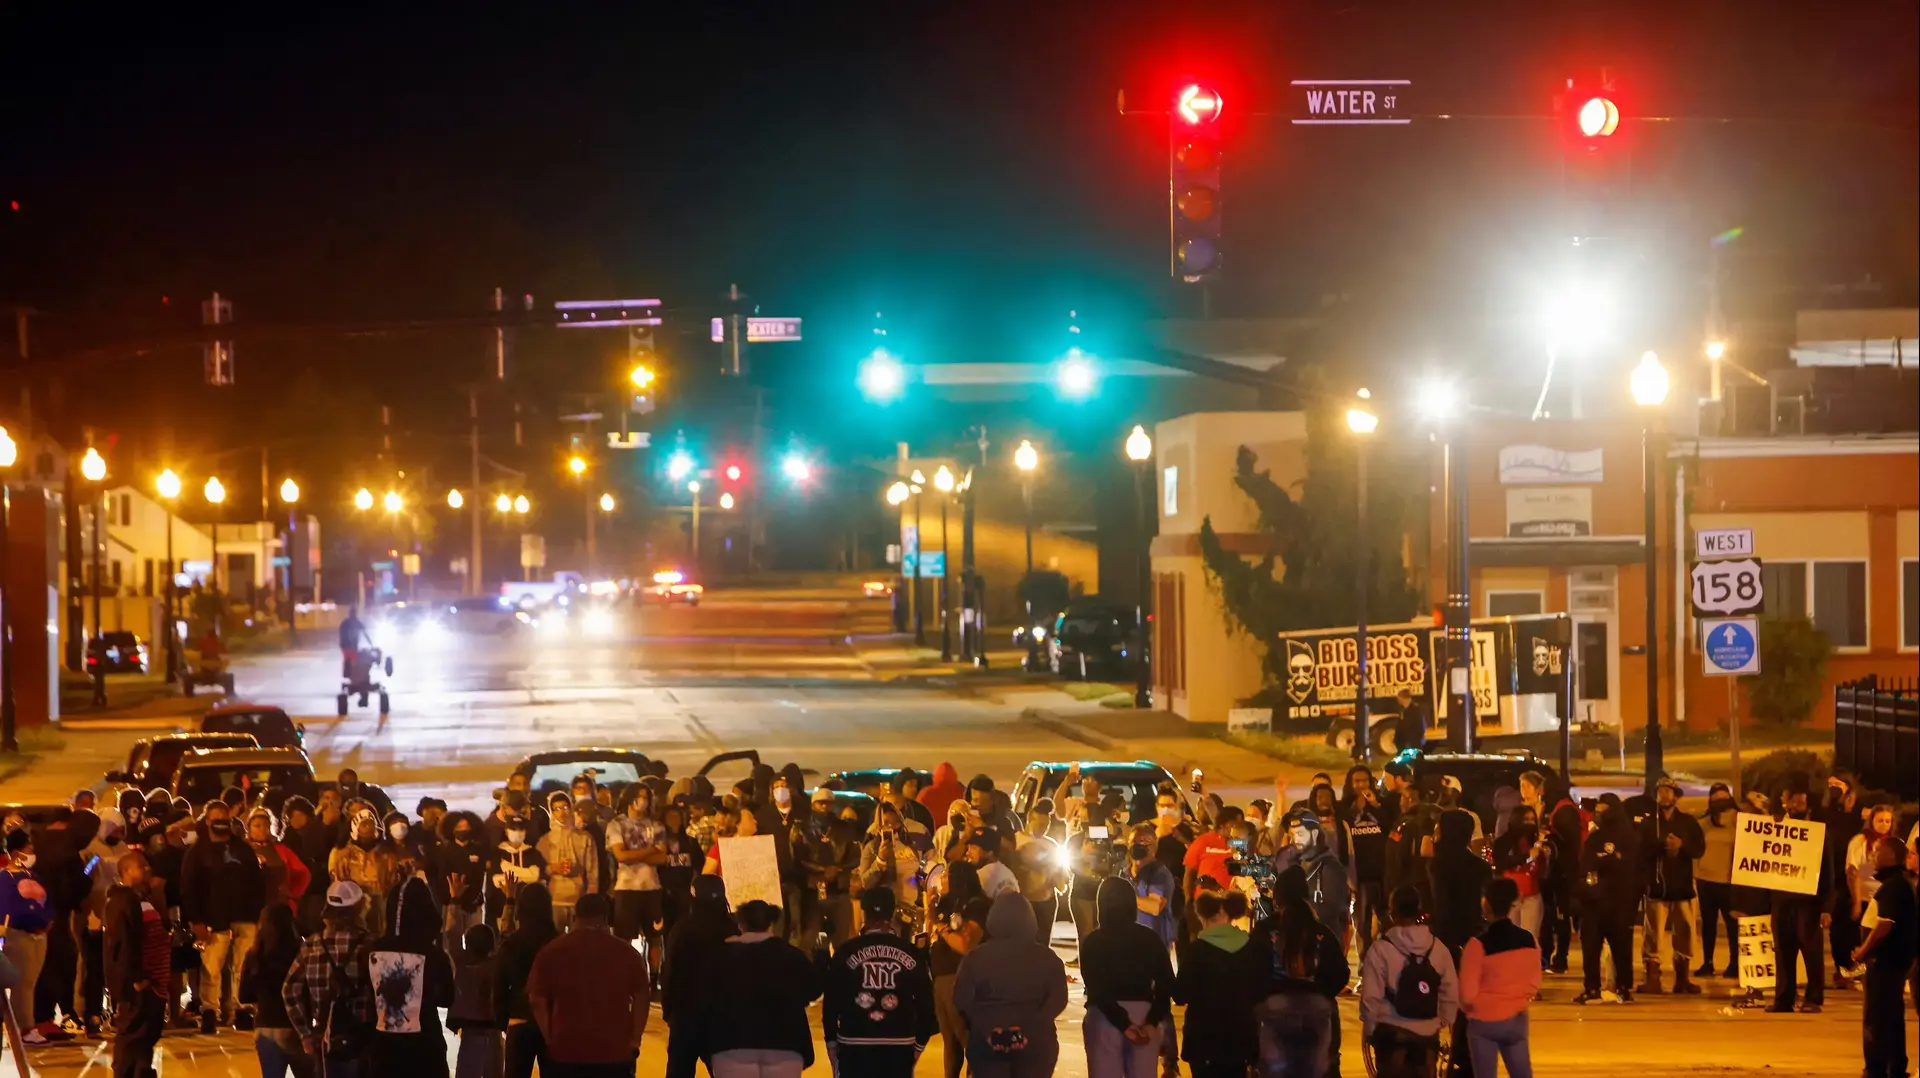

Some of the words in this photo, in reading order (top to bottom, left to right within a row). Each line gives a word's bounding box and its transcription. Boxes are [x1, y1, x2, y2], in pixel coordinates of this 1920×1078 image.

[1306, 90, 1376, 114] WATER
[1384, 96, 1396, 109] ST
[1704, 534, 1745, 551] WEST
[1697, 571, 1756, 603] 158
[1321, 641, 1356, 664] BIG
[1365, 636, 1416, 661] BOSS
[1470, 640, 1486, 667] AT
[1319, 661, 1422, 688] BURRITOS
[1351, 825, 1382, 836] Reebok
[1744, 820, 1809, 841] JUSTICE
[1762, 840, 1792, 857] FOR
[1738, 857, 1807, 880] ANDREW!
[862, 961, 901, 989] NY
[1743, 964, 1775, 978] VIDE
